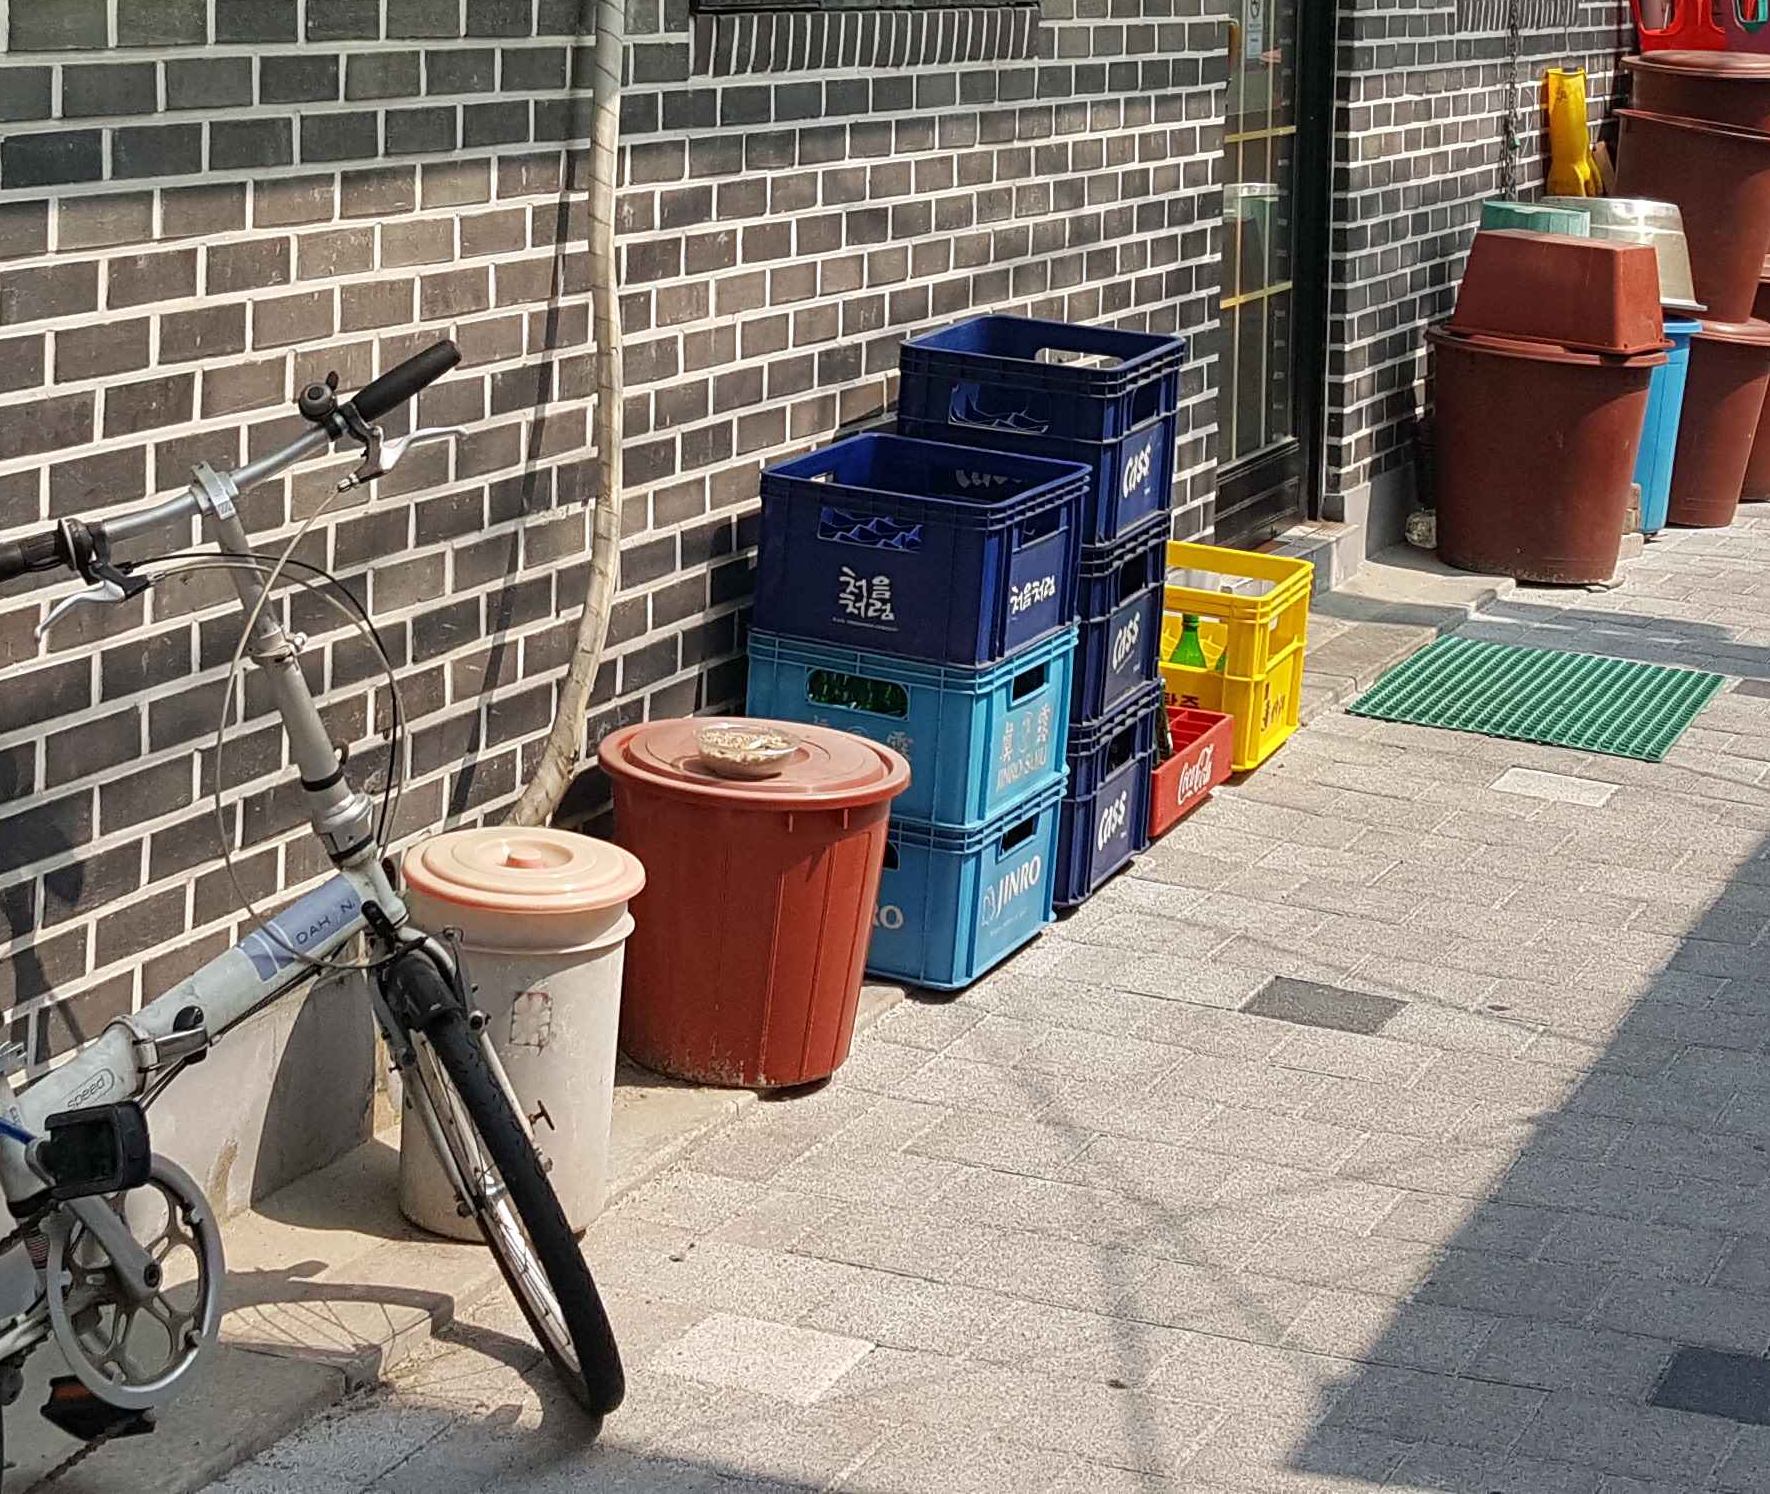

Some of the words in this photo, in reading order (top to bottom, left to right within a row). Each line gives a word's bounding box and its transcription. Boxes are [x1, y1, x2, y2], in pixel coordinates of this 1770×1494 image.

[839, 566, 891, 599] 처음
[839, 593, 895, 620] 처럼
[996, 855, 1042, 917] JINRO
[296, 898, 356, 945] DAHN
